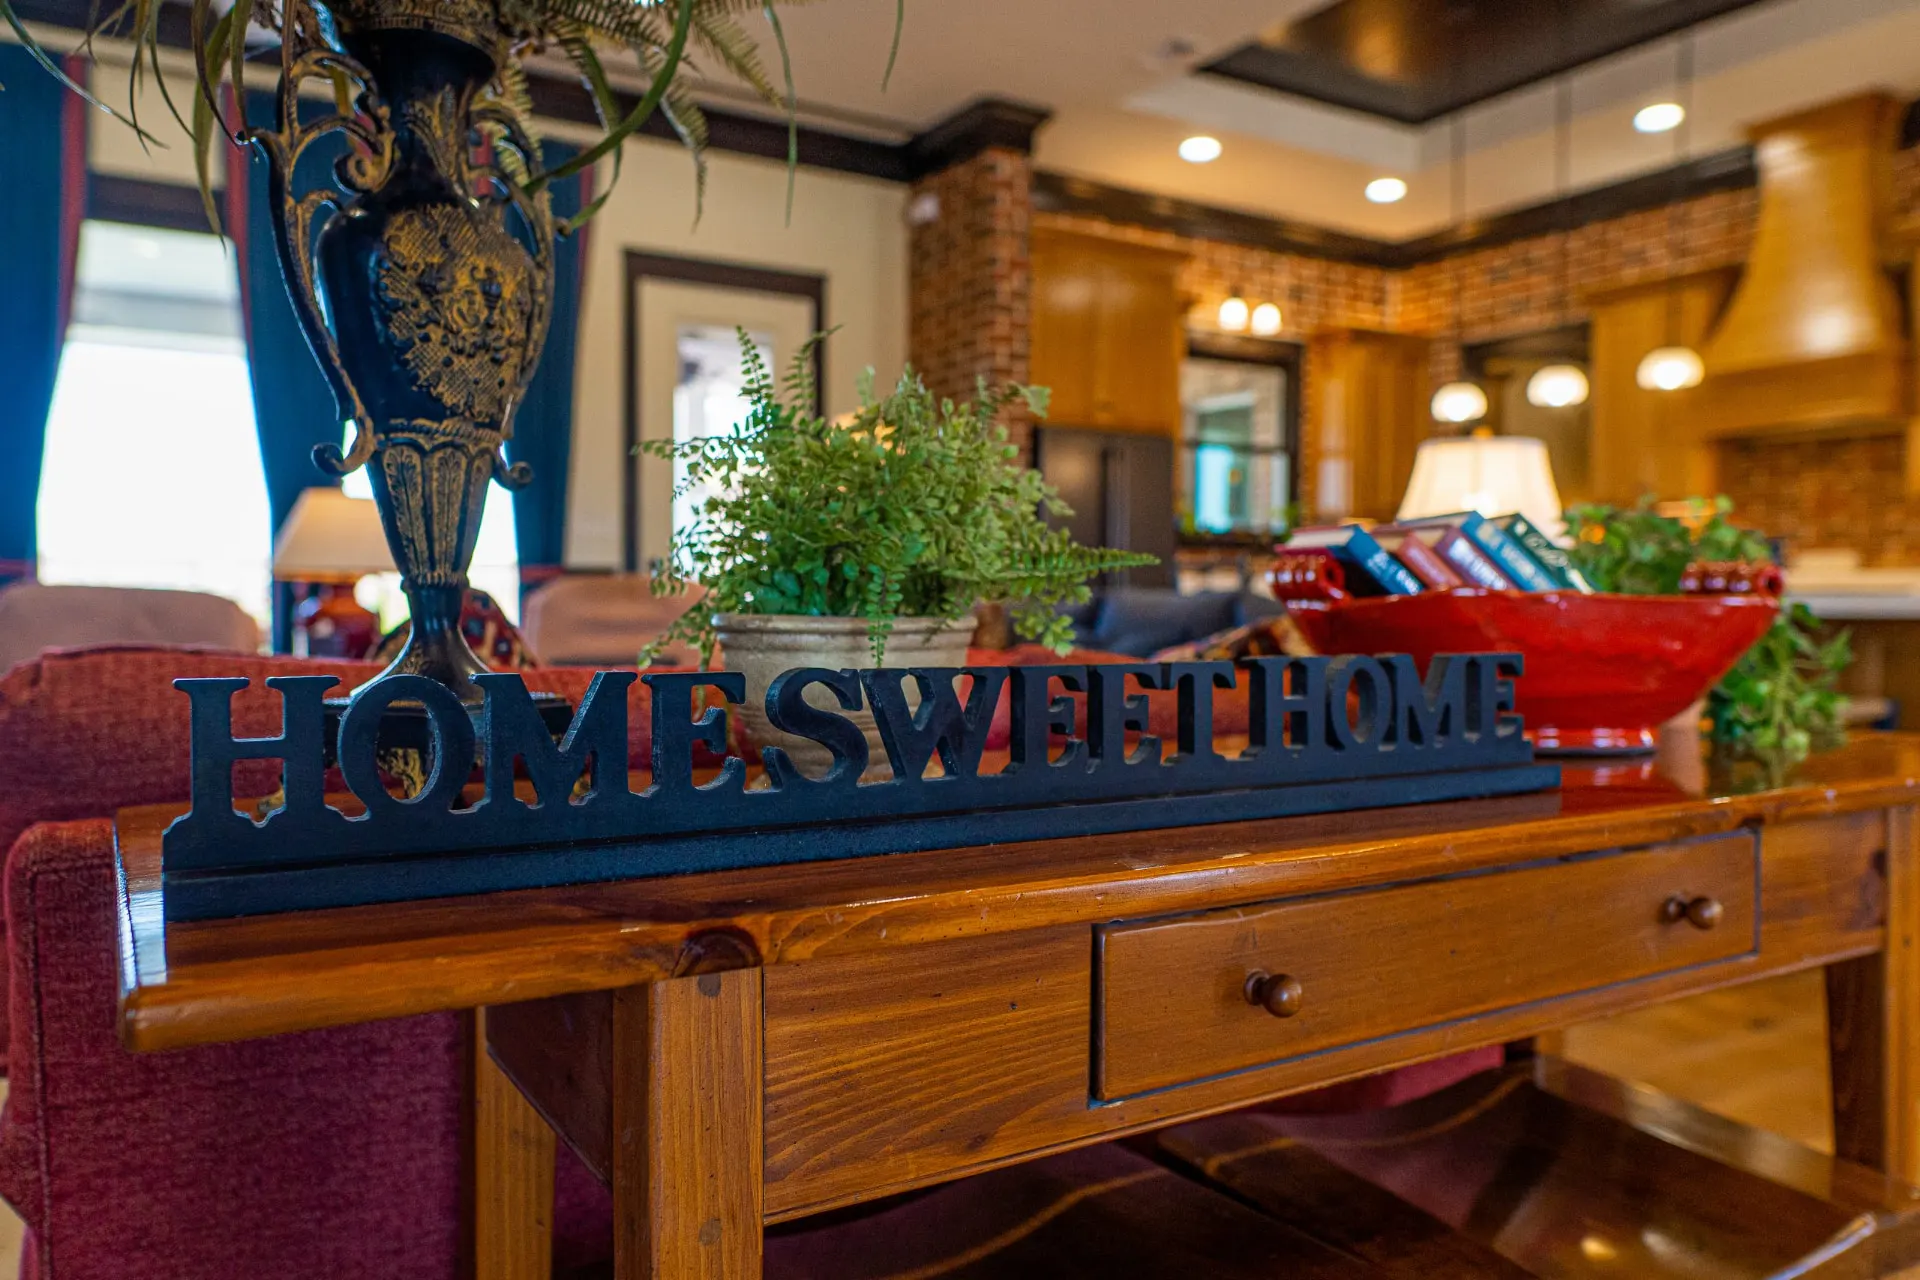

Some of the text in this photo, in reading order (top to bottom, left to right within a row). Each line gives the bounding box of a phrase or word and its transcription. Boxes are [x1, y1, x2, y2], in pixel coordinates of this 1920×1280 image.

[172, 653, 1525, 827] HOME SWEET HOME
